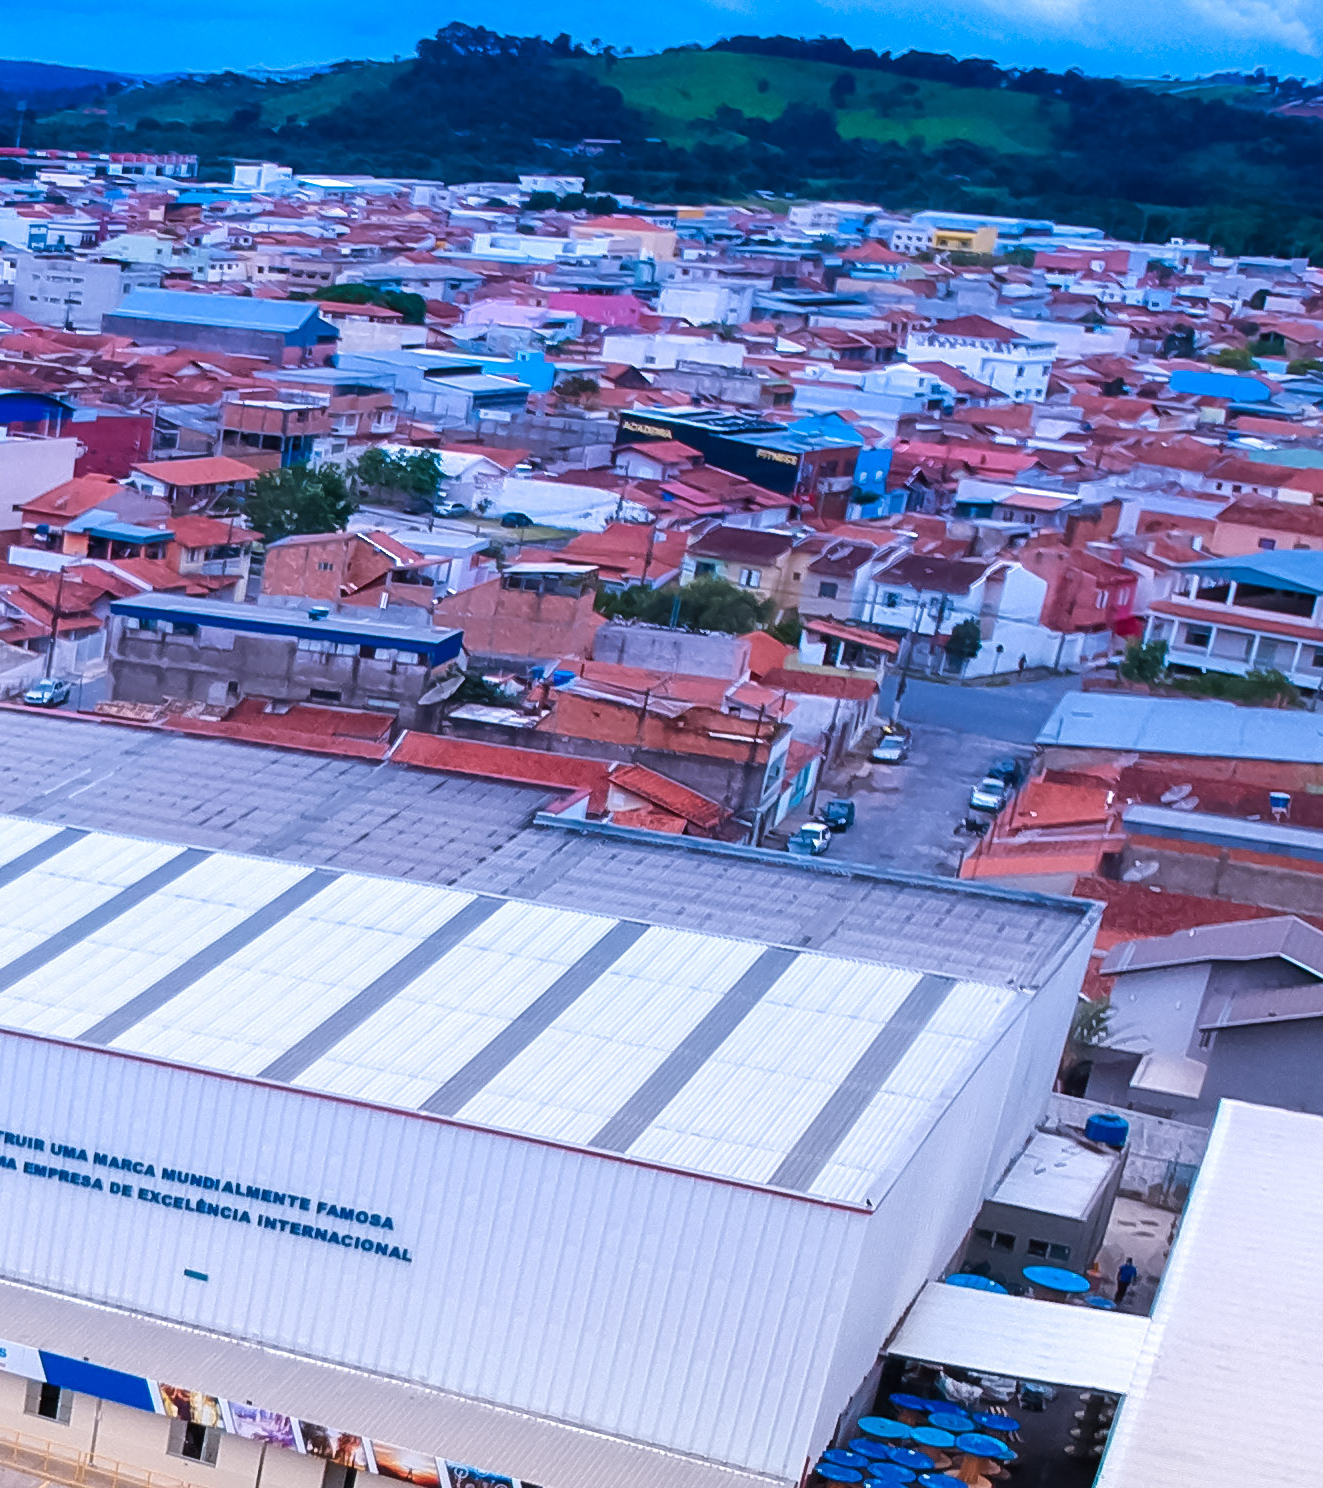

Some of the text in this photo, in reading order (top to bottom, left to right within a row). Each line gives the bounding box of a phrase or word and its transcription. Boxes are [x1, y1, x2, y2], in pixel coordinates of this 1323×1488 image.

[23, 1161, 104, 1191] EMPRESA
[109, 1181, 133, 1197] DE
[138, 1187, 251, 1224] EXCELÊNCIA
[257, 1214, 413, 1262] INTERNACIONAL
[50, 1142, 88, 1162] UMA
[93, 1151, 156, 1178] MARCA
[161, 1167, 311, 1212] MUNDIALMENTE
[316, 1201, 394, 1231] FAMOSA
